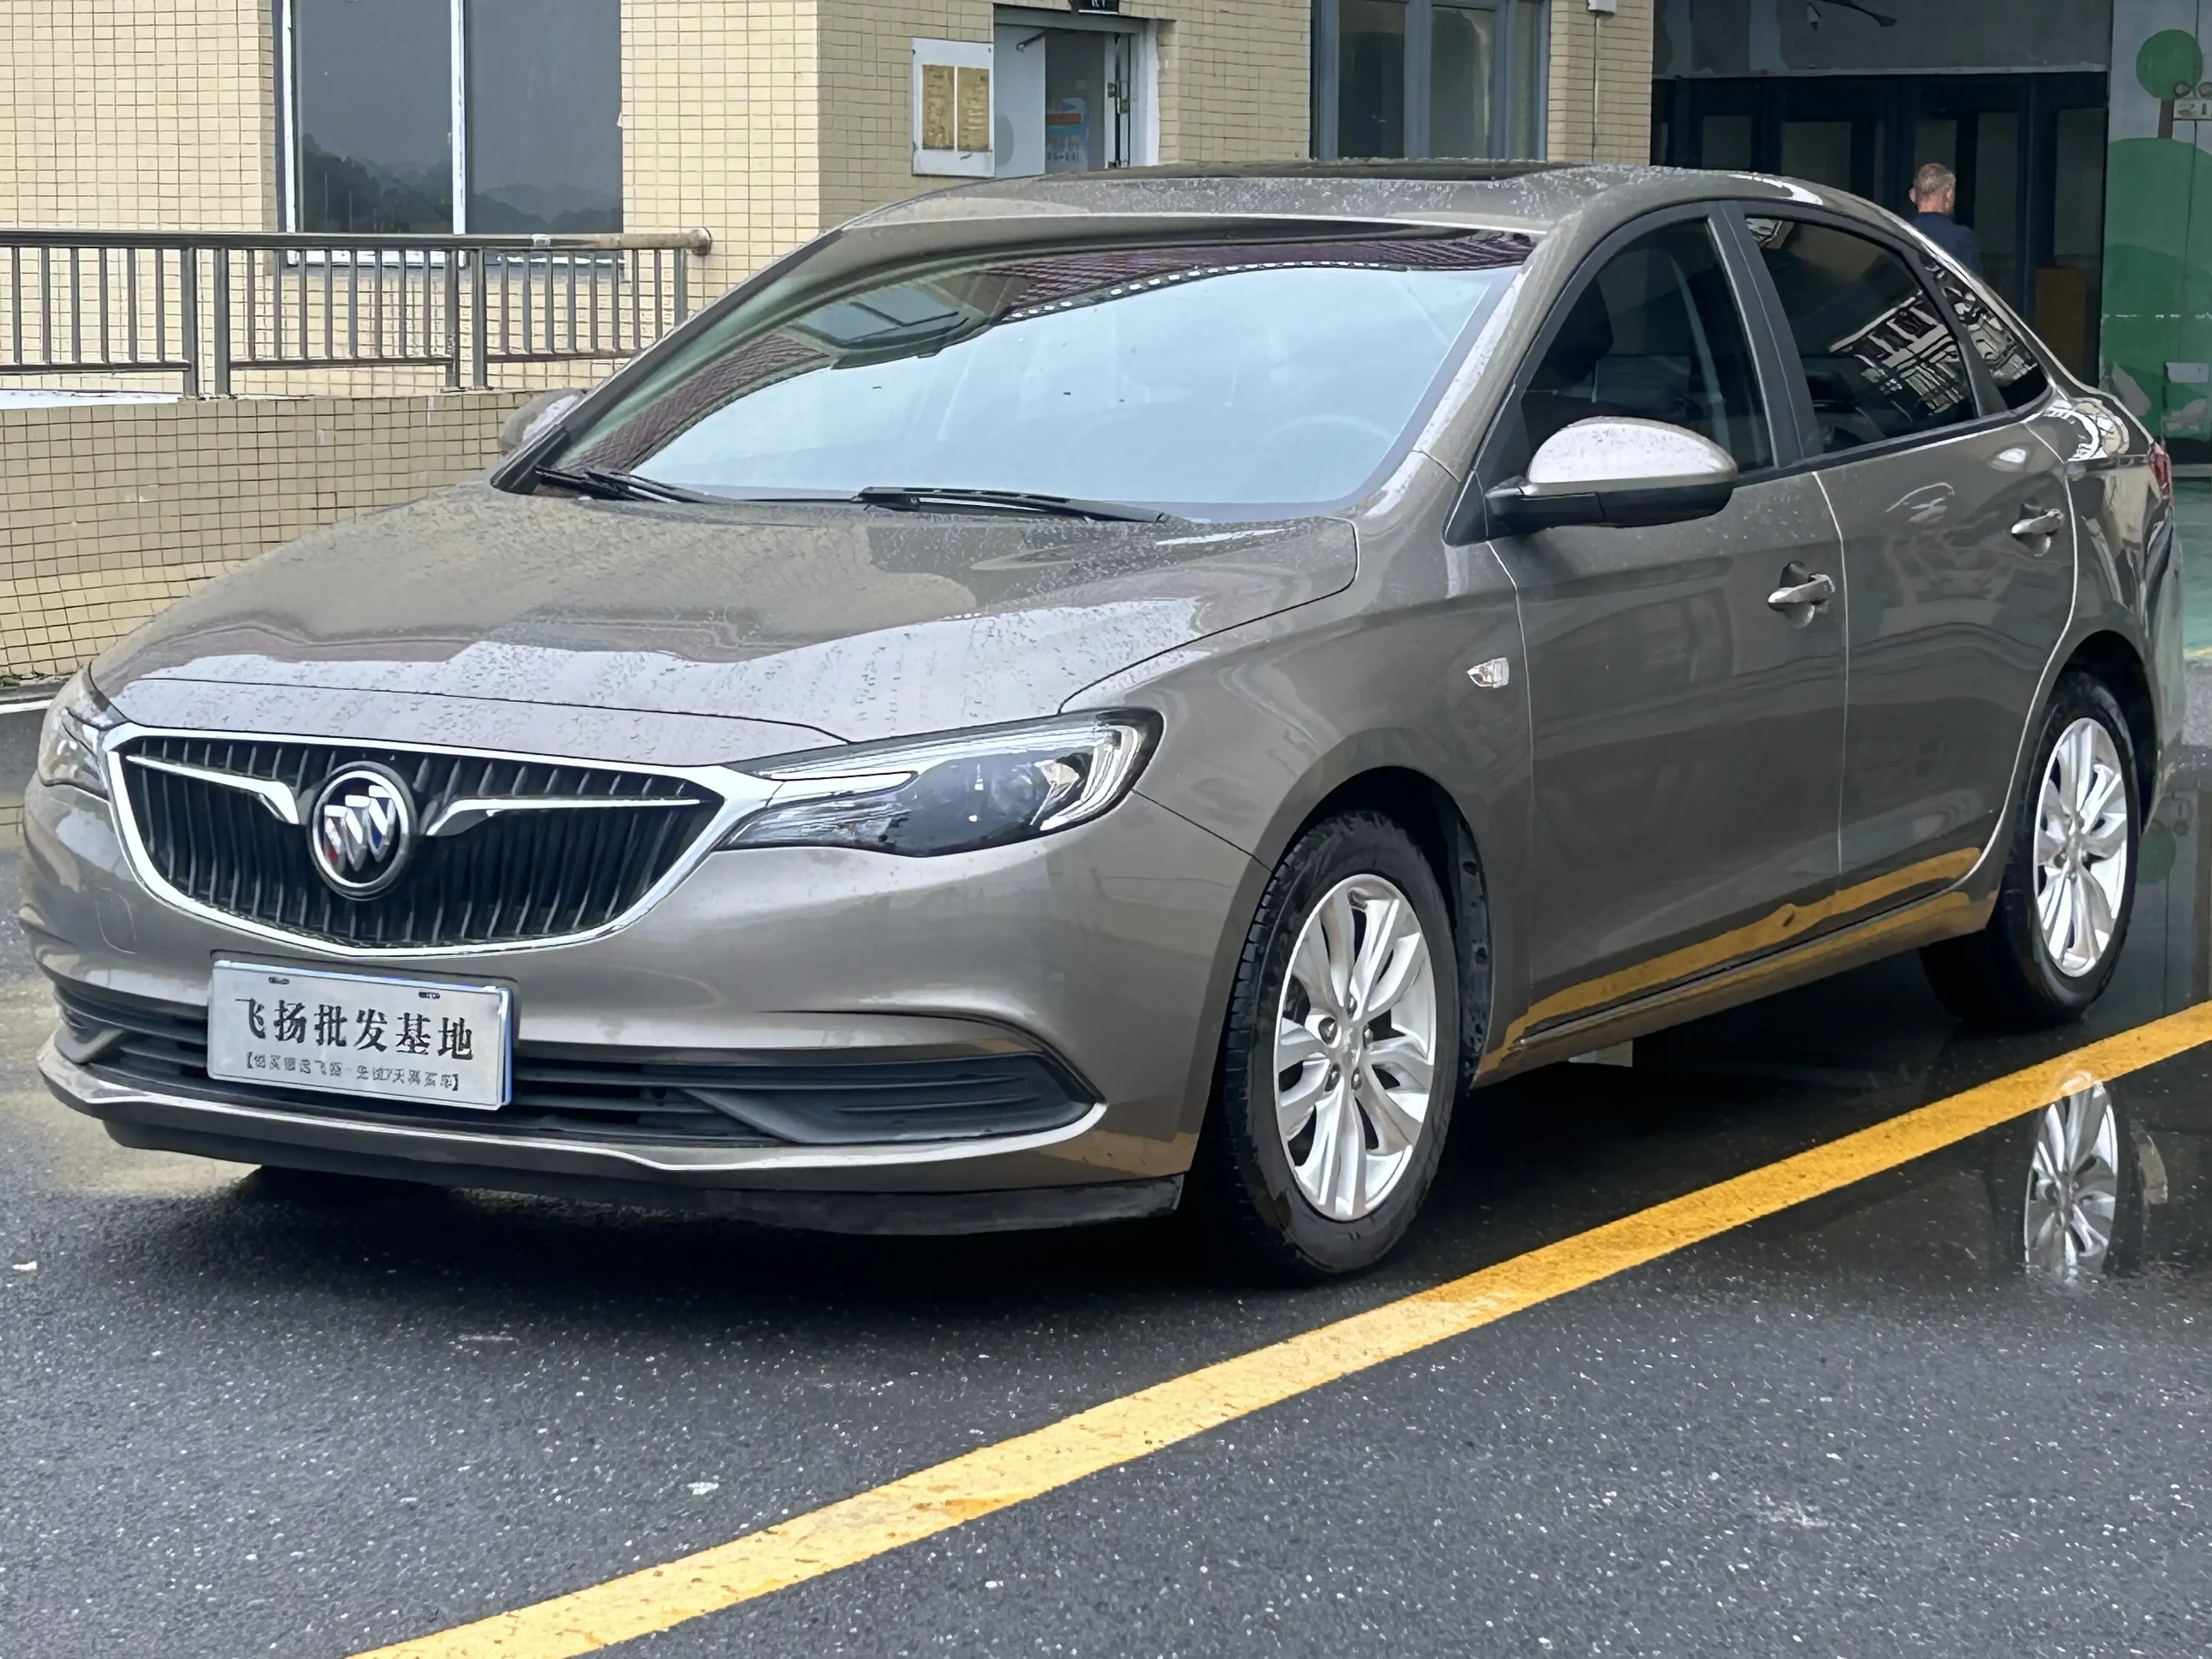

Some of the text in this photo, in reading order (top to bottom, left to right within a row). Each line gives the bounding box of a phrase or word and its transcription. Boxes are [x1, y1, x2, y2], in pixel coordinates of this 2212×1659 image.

[235, 997, 473, 1060] 飞扬批发基地
